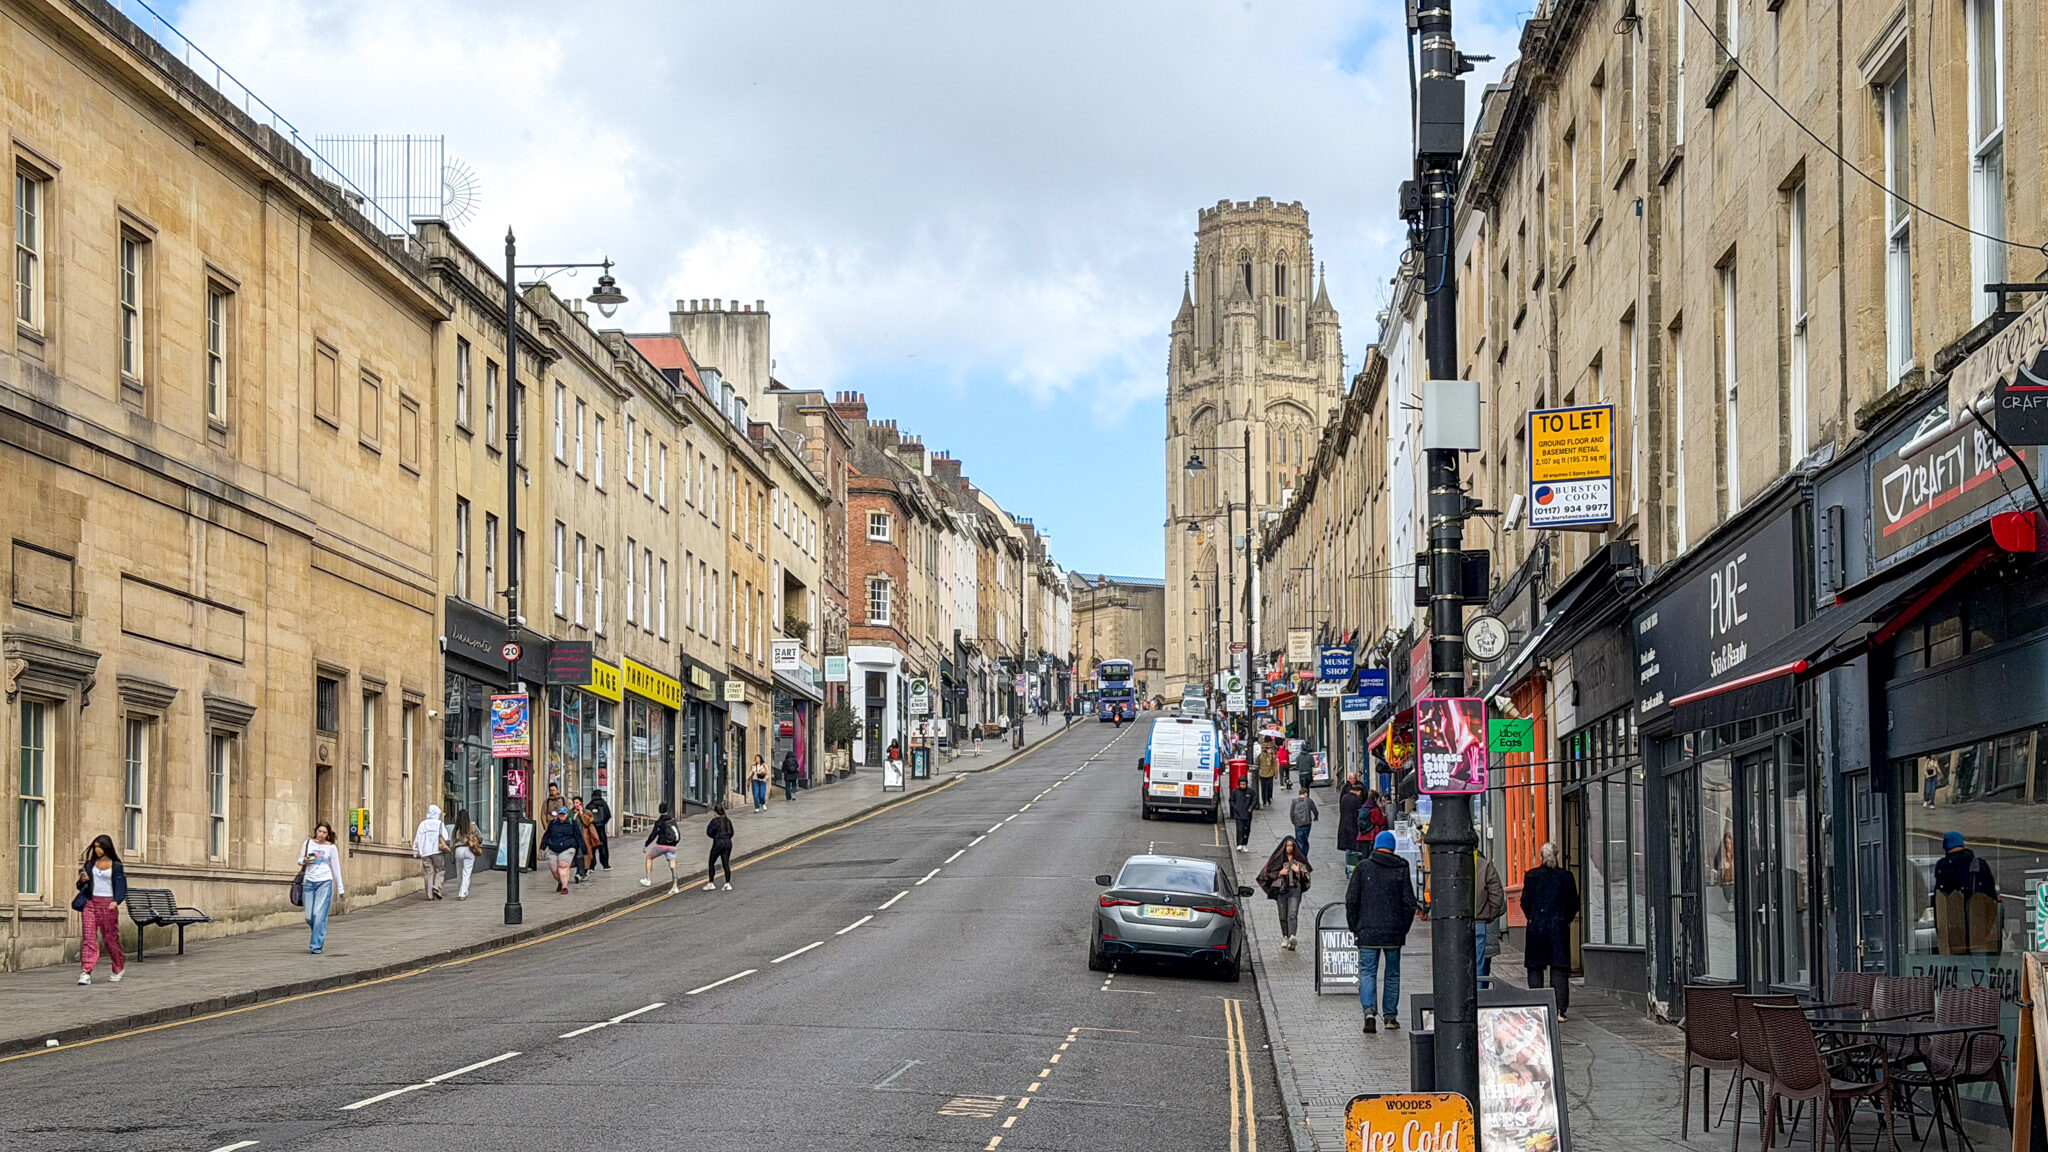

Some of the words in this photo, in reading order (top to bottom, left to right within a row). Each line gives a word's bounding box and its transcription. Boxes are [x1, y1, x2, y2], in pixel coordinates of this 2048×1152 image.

[1539, 415, 1564, 433] TO
[1570, 411, 1603, 431] LET
[1538, 440, 1566, 448] GROUND
[1567, 437, 1589, 446] FLOOR
[1542, 448, 1576, 457] BASEMENT
[1578, 446, 1600, 454] RETAIL
[1912, 436, 1965, 509] CRAFTY
[1555, 483, 1608, 494] BURSTON
[1565, 493, 1598, 502] COOK
[1534, 505, 1560, 515] (0117)
[1564, 505, 1582, 513] 934
[1586, 503, 1608, 512] 9977
[1535, 512, 1608, 521] www.burstoncook.co.uk
[1710, 552, 1747, 640] PURE
[504, 647, 518, 655] 20
[781, 648, 797, 656] ART
[1324, 658, 1351, 666] MUSIC
[627, 666, 654, 692] THRIFT
[657, 679, 680, 704] STORE
[1500, 739, 1522, 747] Eats
[1197, 731, 1211, 770] Initial
[1423, 752, 1463, 762] PLEASE
[1423, 762, 1448, 773] BIN
[1425, 772, 1450, 780] YOUR
[1322, 932, 1358, 948] VINTAGE
[1323, 951, 1359, 963] REWORKED
[1323, 962, 1359, 975] CLOTHING
[1385, 1100, 1432, 1110] WOODES
[1357, 1120, 1396, 1152] Ice
[1402, 1119, 1460, 1152] Cold
